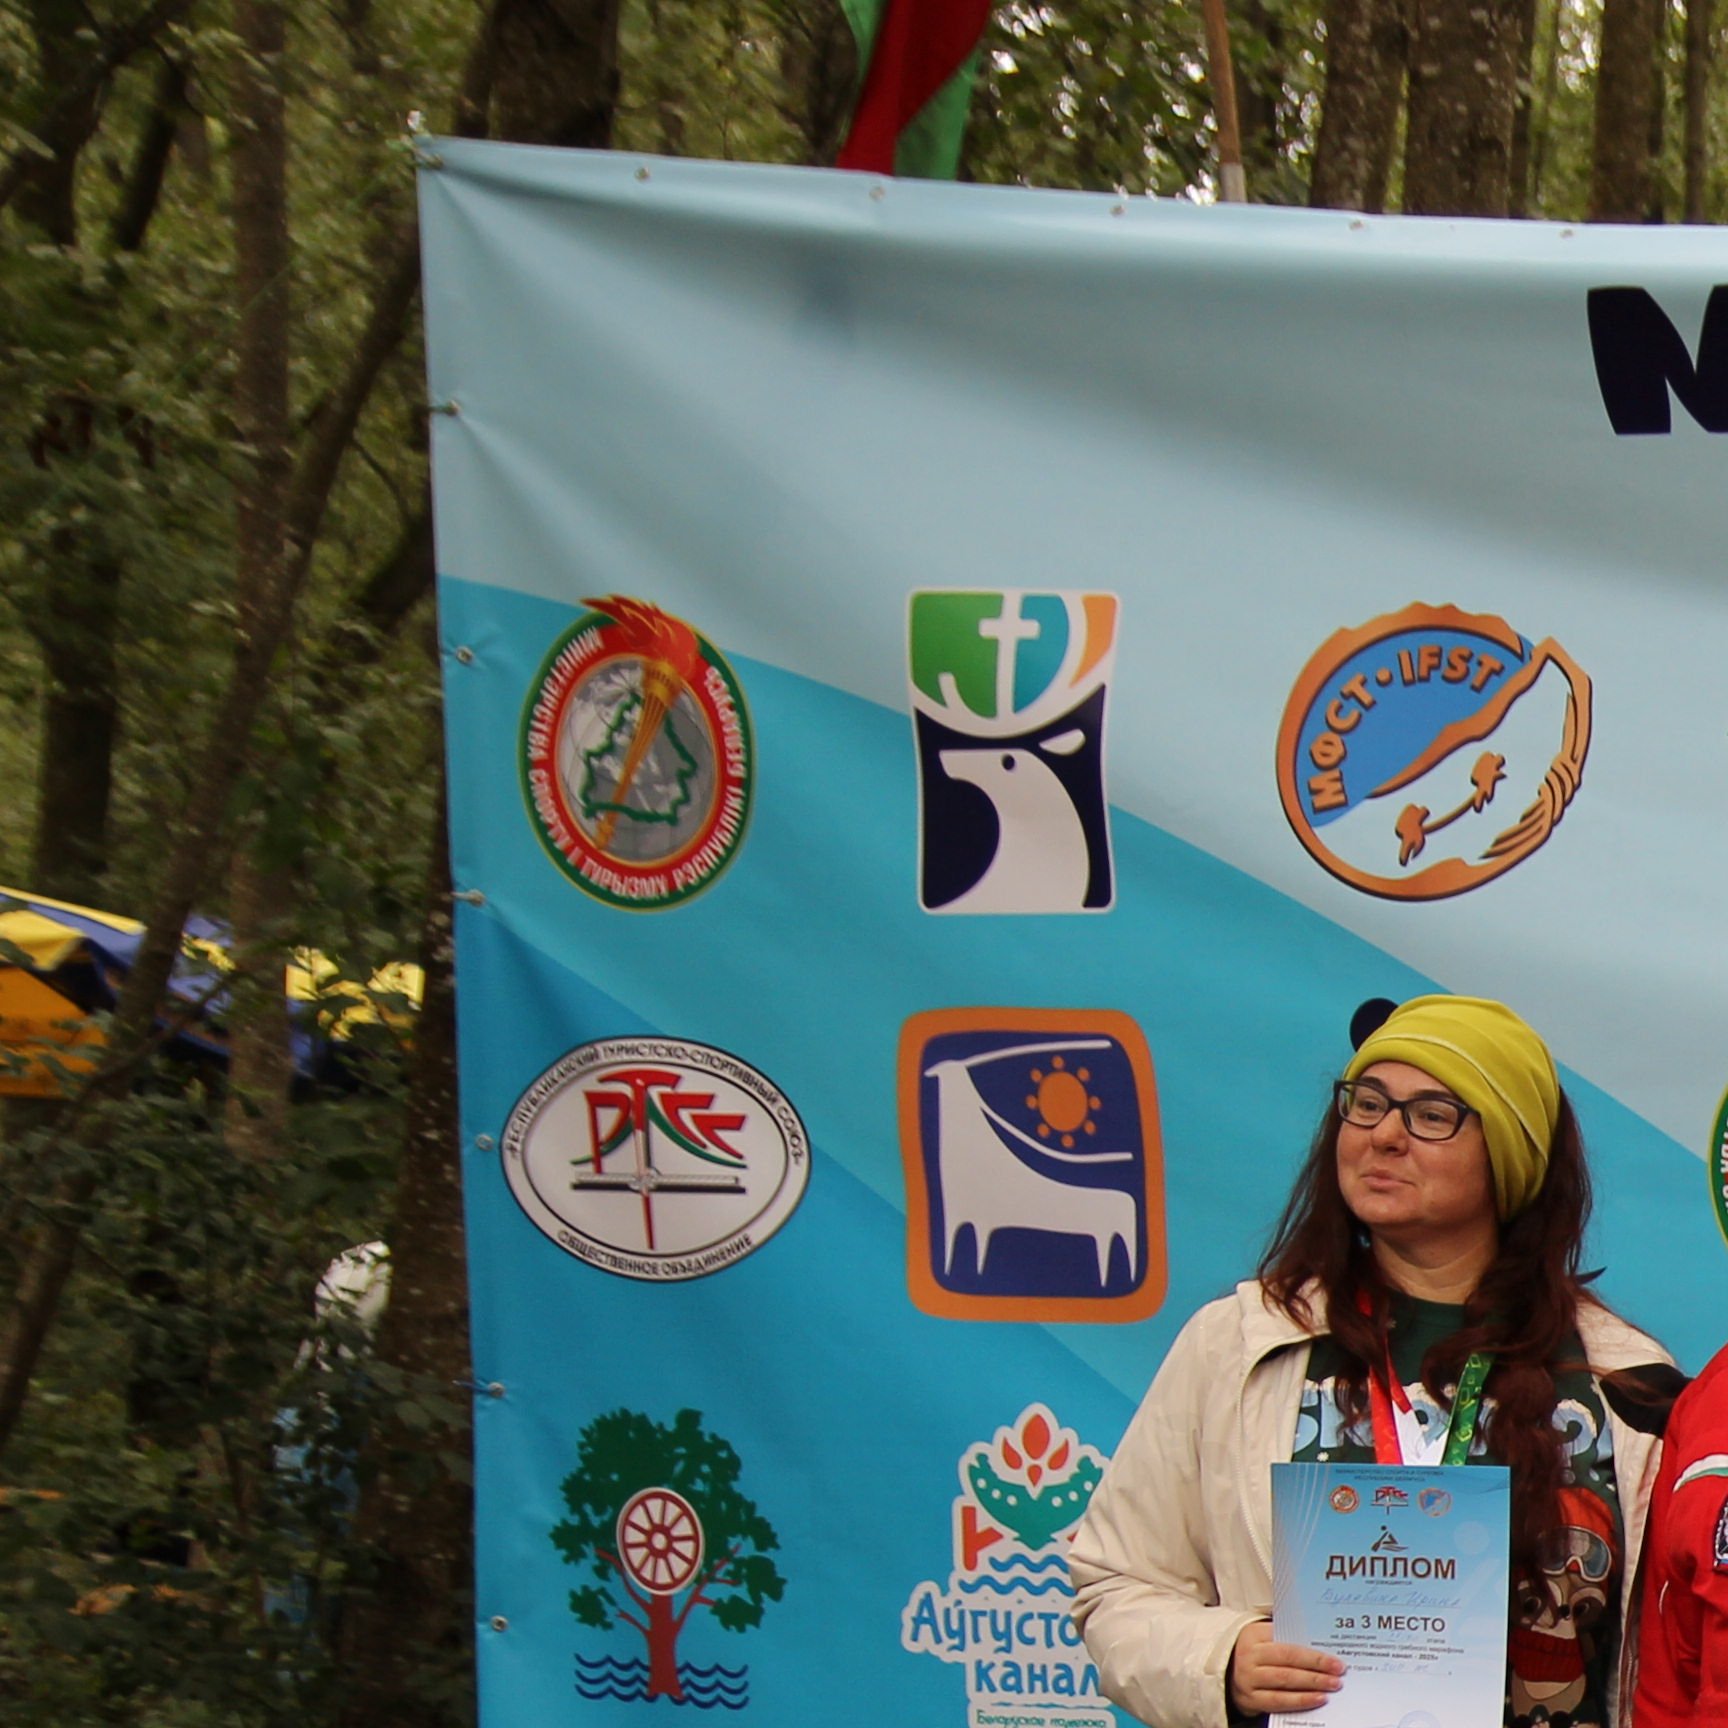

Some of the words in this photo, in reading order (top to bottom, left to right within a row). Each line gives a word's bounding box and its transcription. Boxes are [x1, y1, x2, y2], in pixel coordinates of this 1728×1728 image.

[557, 1228, 661, 1276] ОБЩЕСТВЕННОЕ
[661, 1231, 753, 1276] ОБЪЕДИНЕНИЕ
[1325, 1554, 1457, 1581] ДИПЛОМ
[910, 1591, 1082, 1653] Аўгусто
[1335, 1616, 1355, 1629] за
[1360, 1615, 1372, 1629] 3
[1377, 1615, 1446, 1632] МЕСТО
[975, 1659, 1100, 1697] канал
